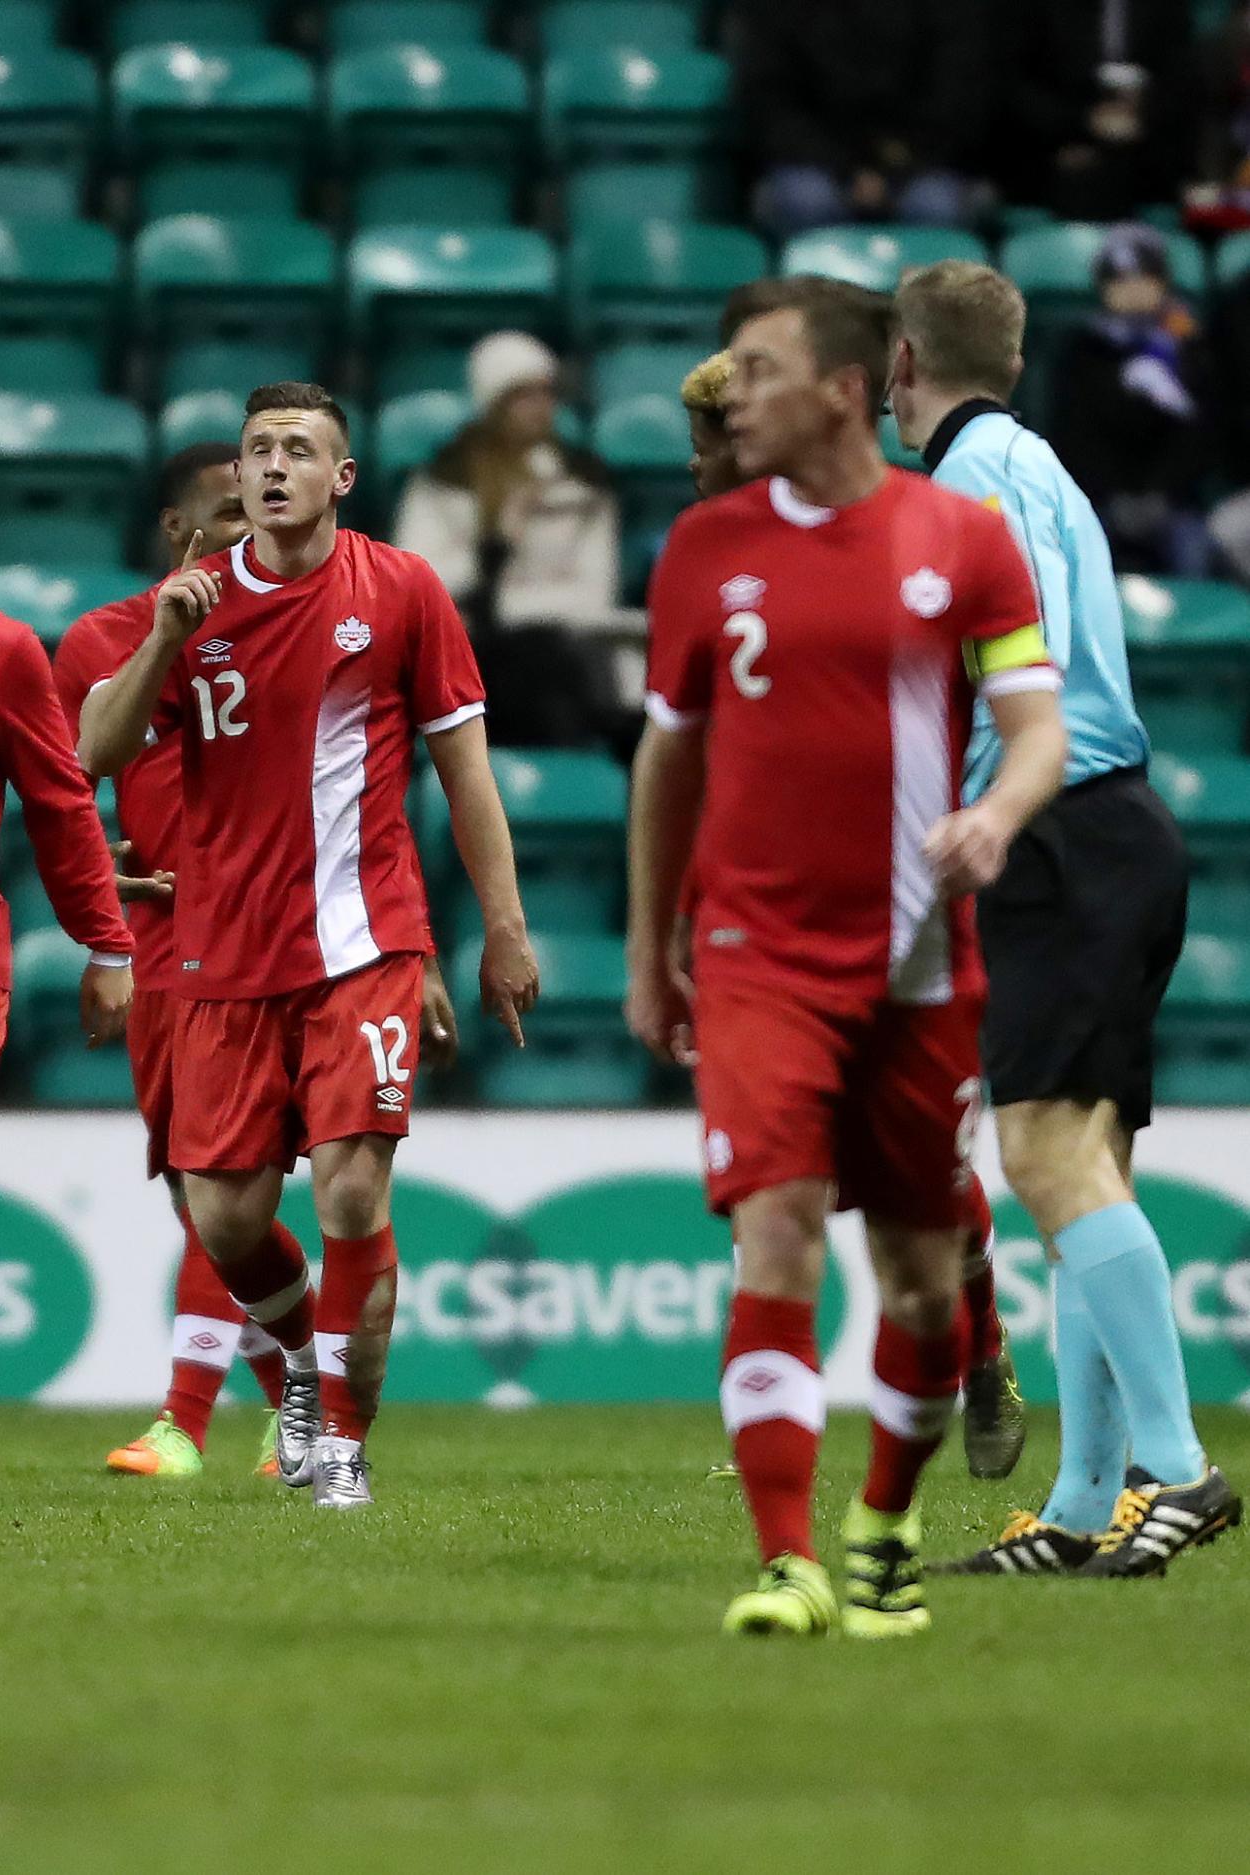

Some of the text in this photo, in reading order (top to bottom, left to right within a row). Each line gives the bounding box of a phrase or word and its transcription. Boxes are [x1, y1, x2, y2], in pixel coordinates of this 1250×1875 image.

[200, 654, 232, 664] umbro
[722, 609, 773, 700] 2
[190, 669, 249, 740] 12
[359, 1014, 408, 1084] 12
[376, 1102, 404, 1113] umbro
